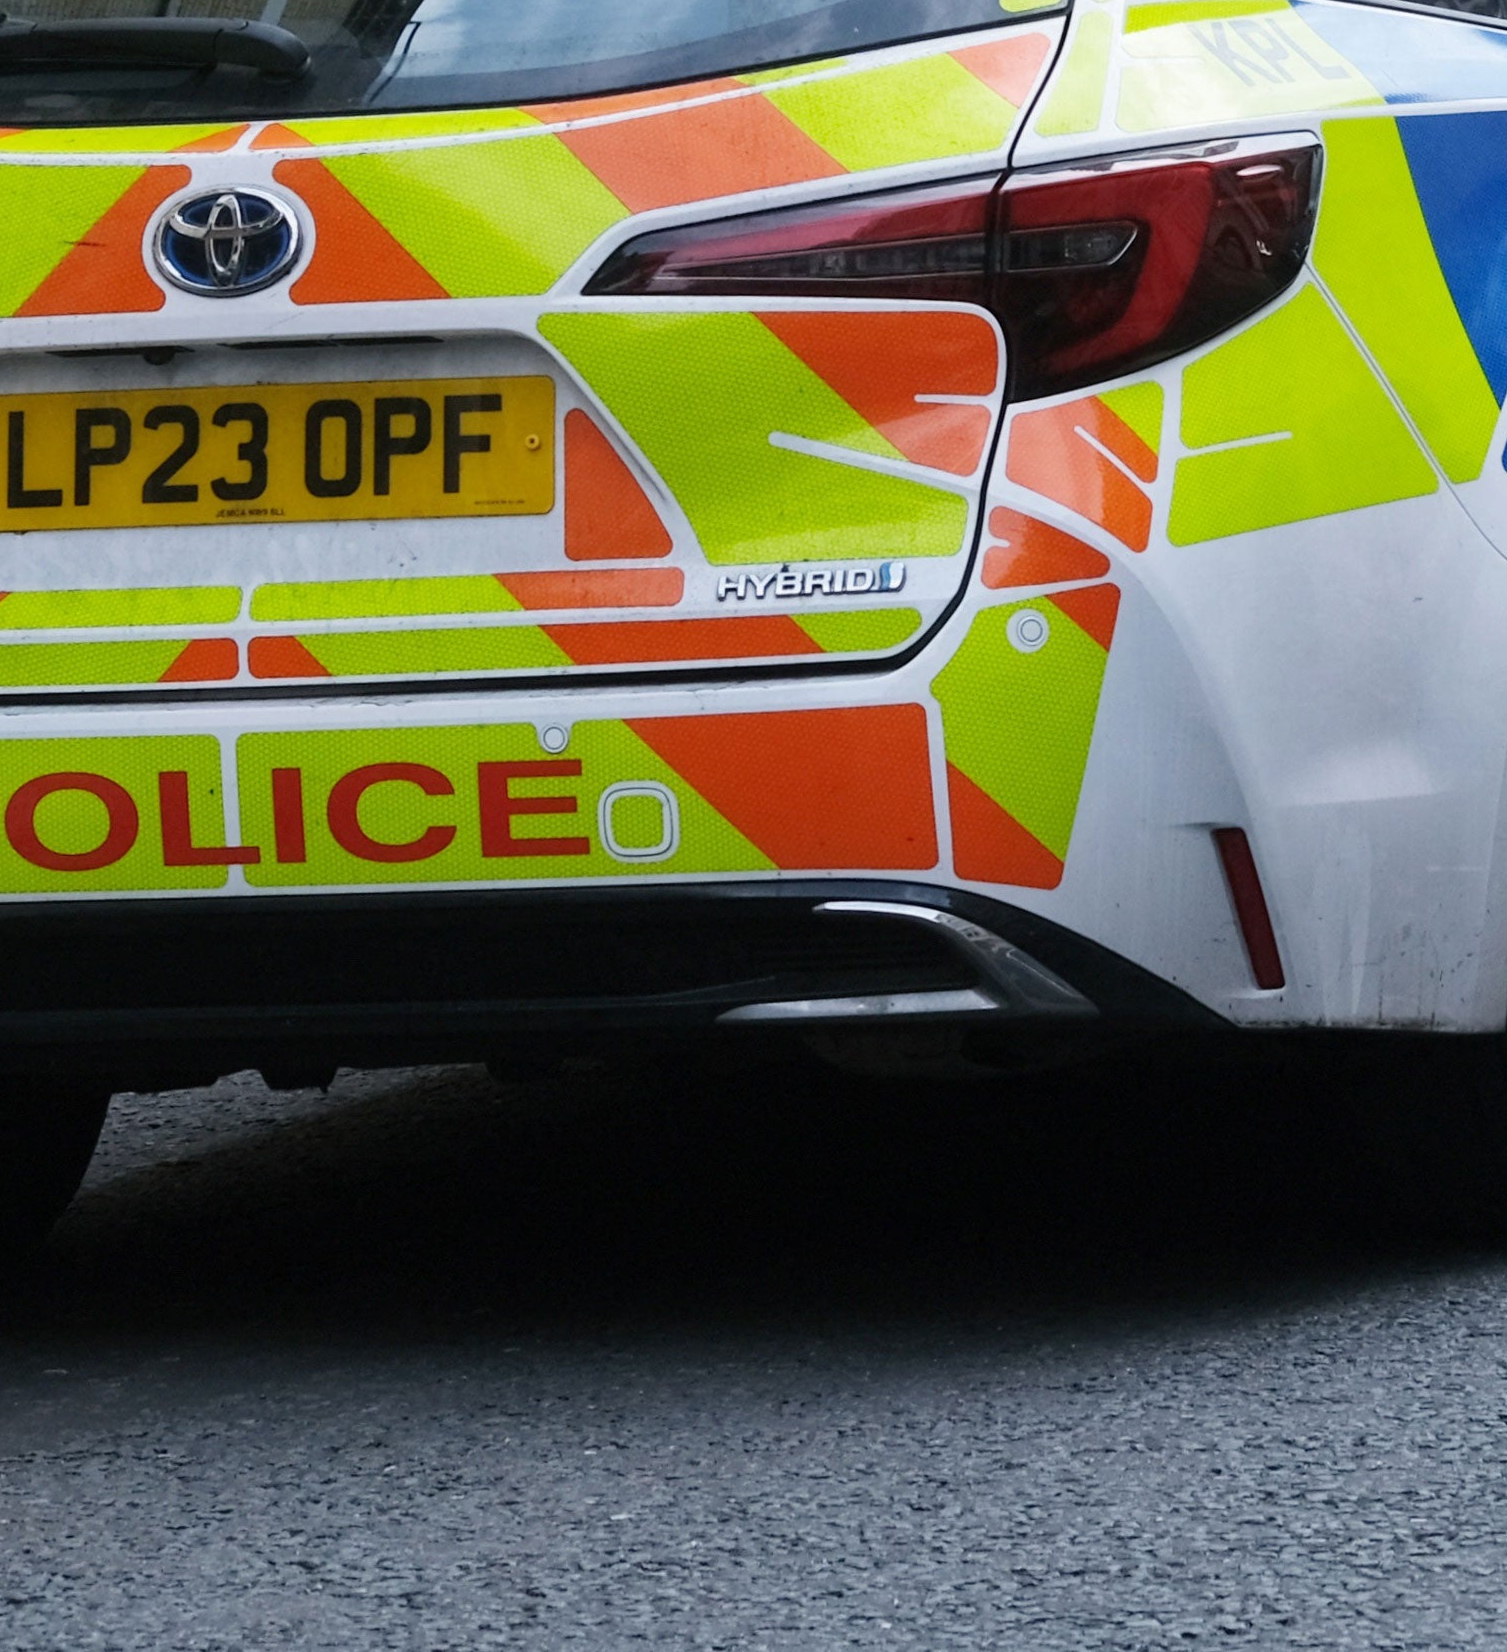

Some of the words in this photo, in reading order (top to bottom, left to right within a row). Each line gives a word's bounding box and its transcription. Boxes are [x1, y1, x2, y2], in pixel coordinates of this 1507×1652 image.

[1185, 17, 1352, 87] KPL
[6, 401, 269, 509] LP23
[304, 394, 503, 498] OPF
[716, 565, 875, 600] HYBRID
